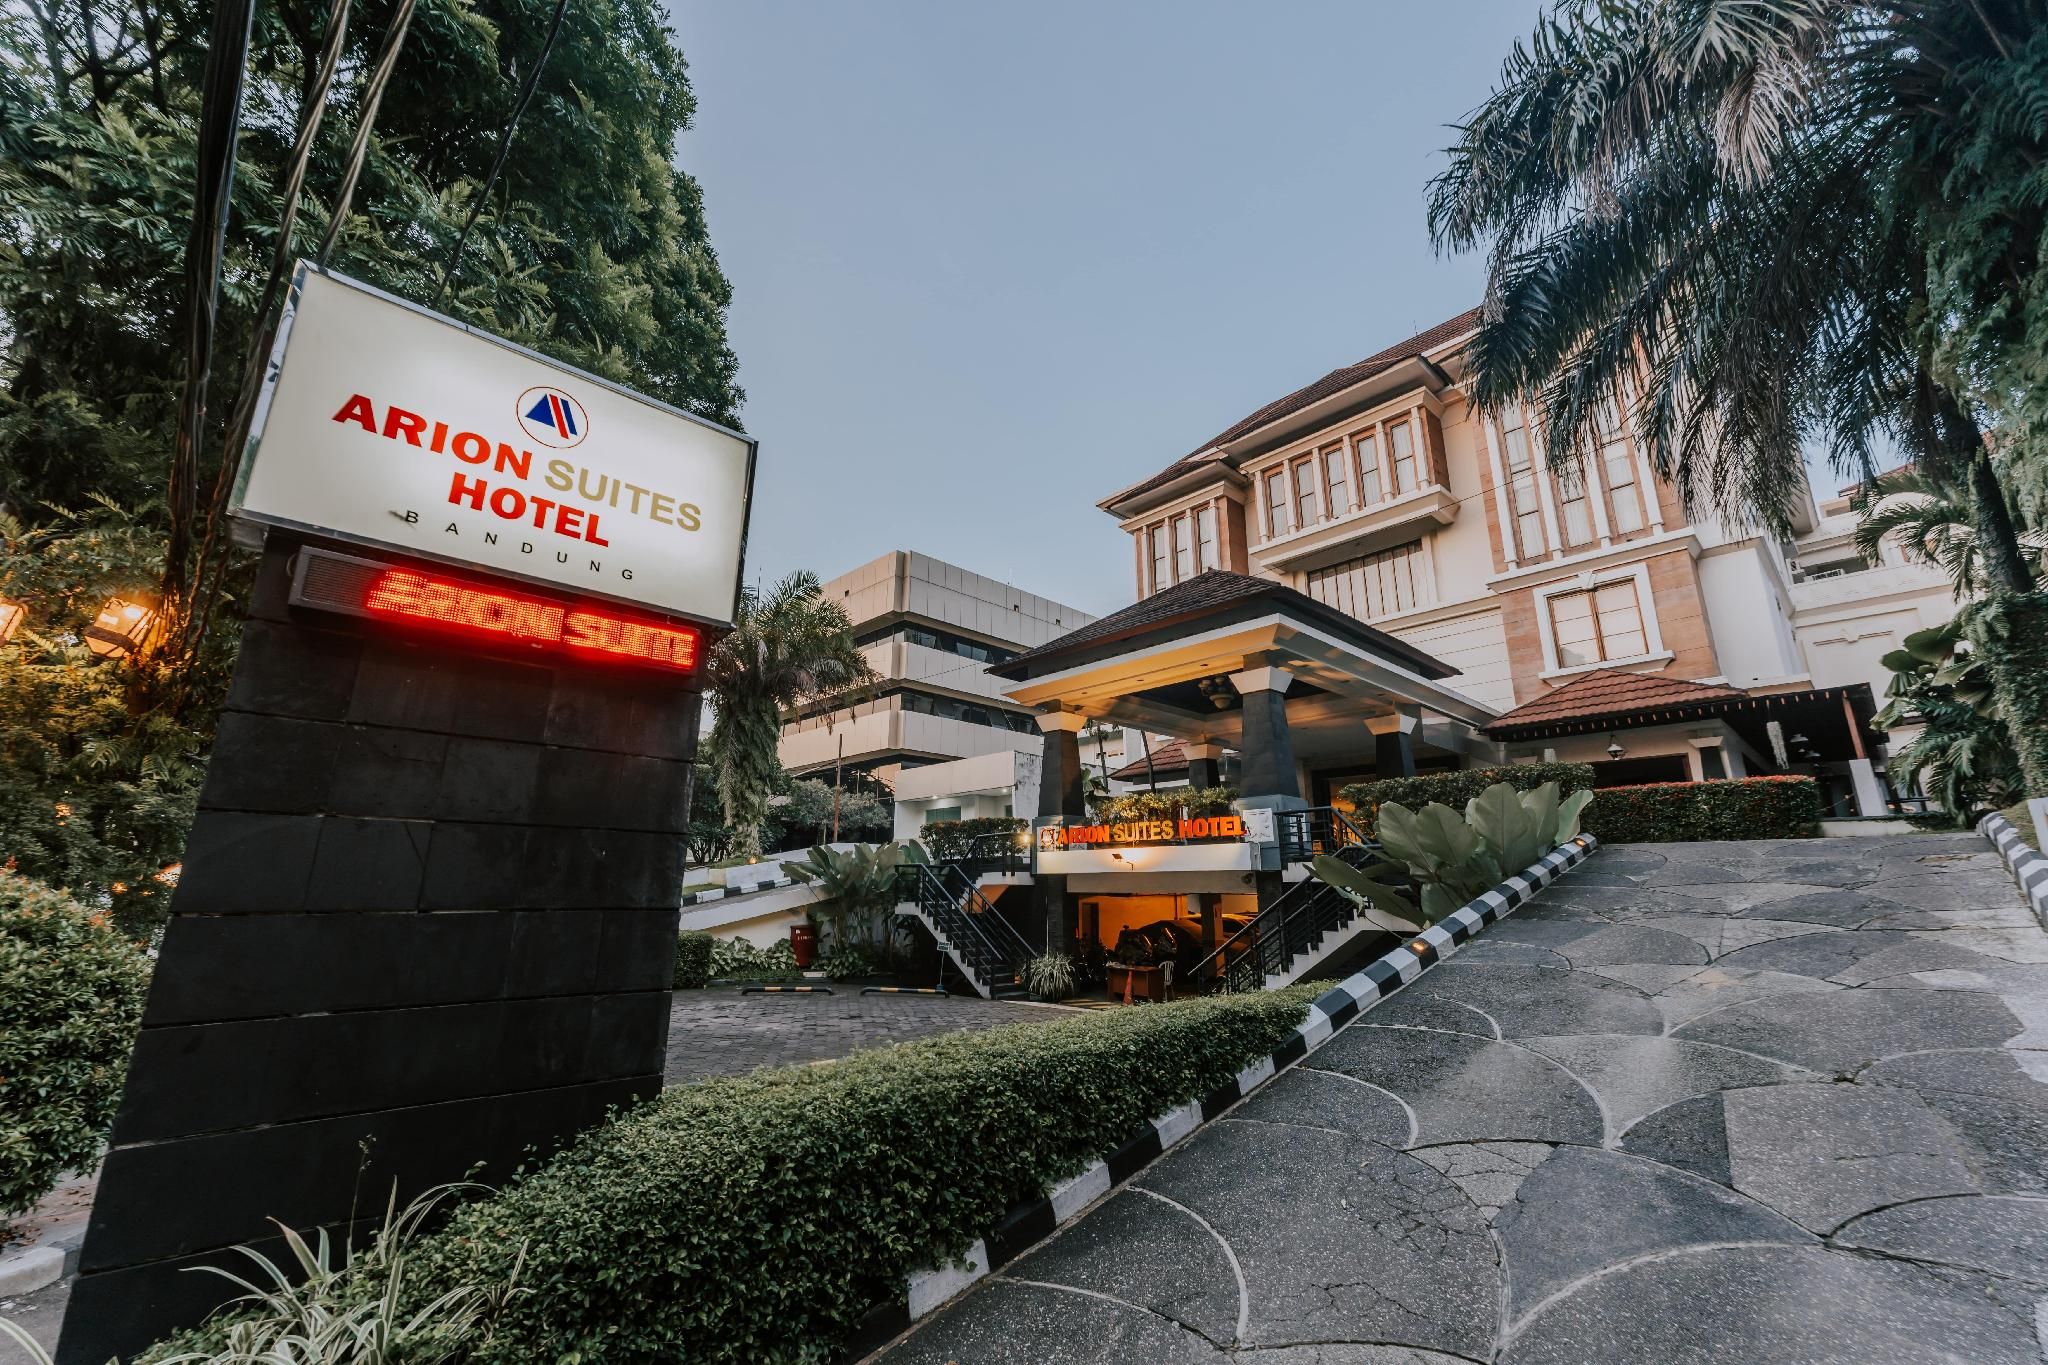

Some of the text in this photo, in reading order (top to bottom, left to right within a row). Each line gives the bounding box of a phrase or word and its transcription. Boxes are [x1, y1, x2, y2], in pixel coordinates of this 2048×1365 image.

[332, 393, 702, 532] ARION SUITES
[404, 509, 634, 581] BANDUNG
[448, 472, 610, 548] HOTEL
[1057, 815, 1247, 845] ARION SUITES HOTEL
